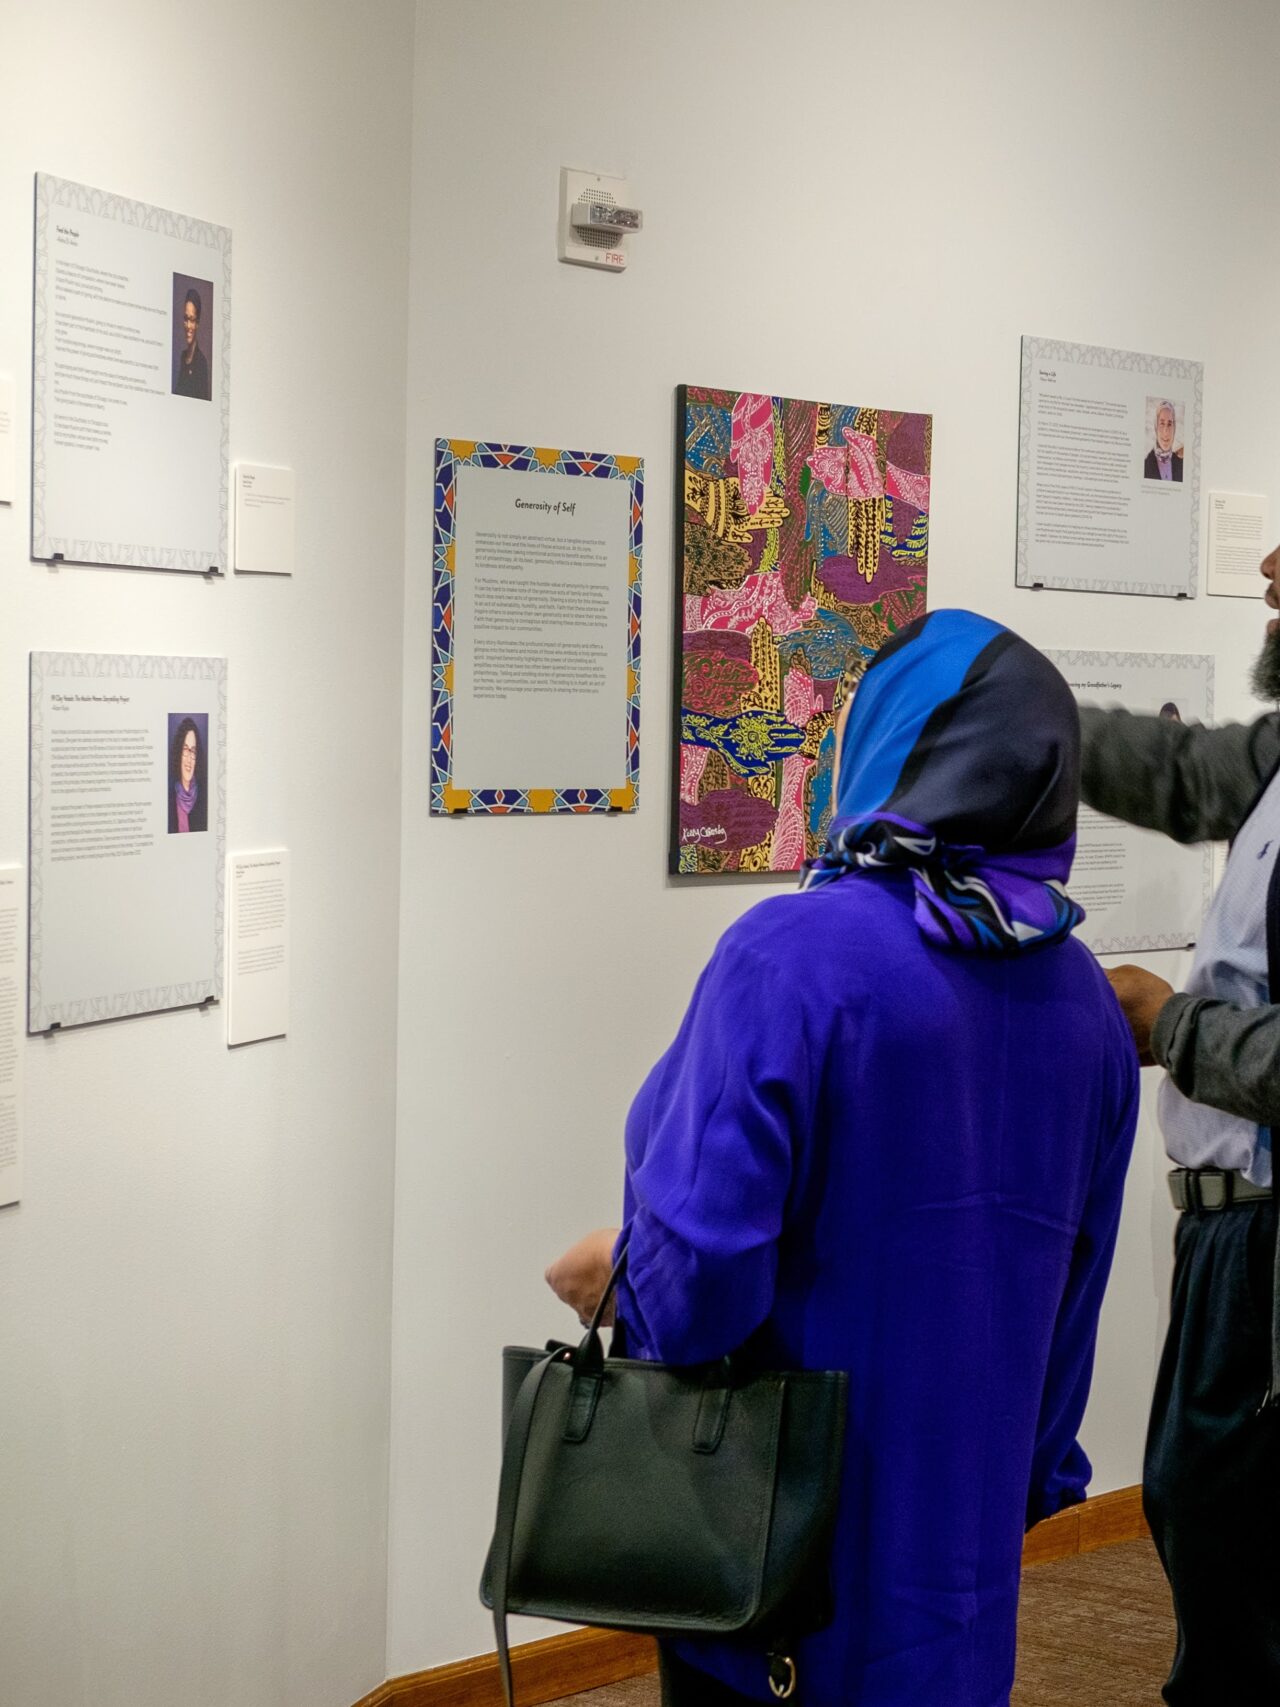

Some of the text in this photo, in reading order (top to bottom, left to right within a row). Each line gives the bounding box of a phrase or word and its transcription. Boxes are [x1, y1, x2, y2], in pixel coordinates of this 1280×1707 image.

[605, 252, 625, 265] FIRE
[515, 498, 576, 516] Generosity of Self
